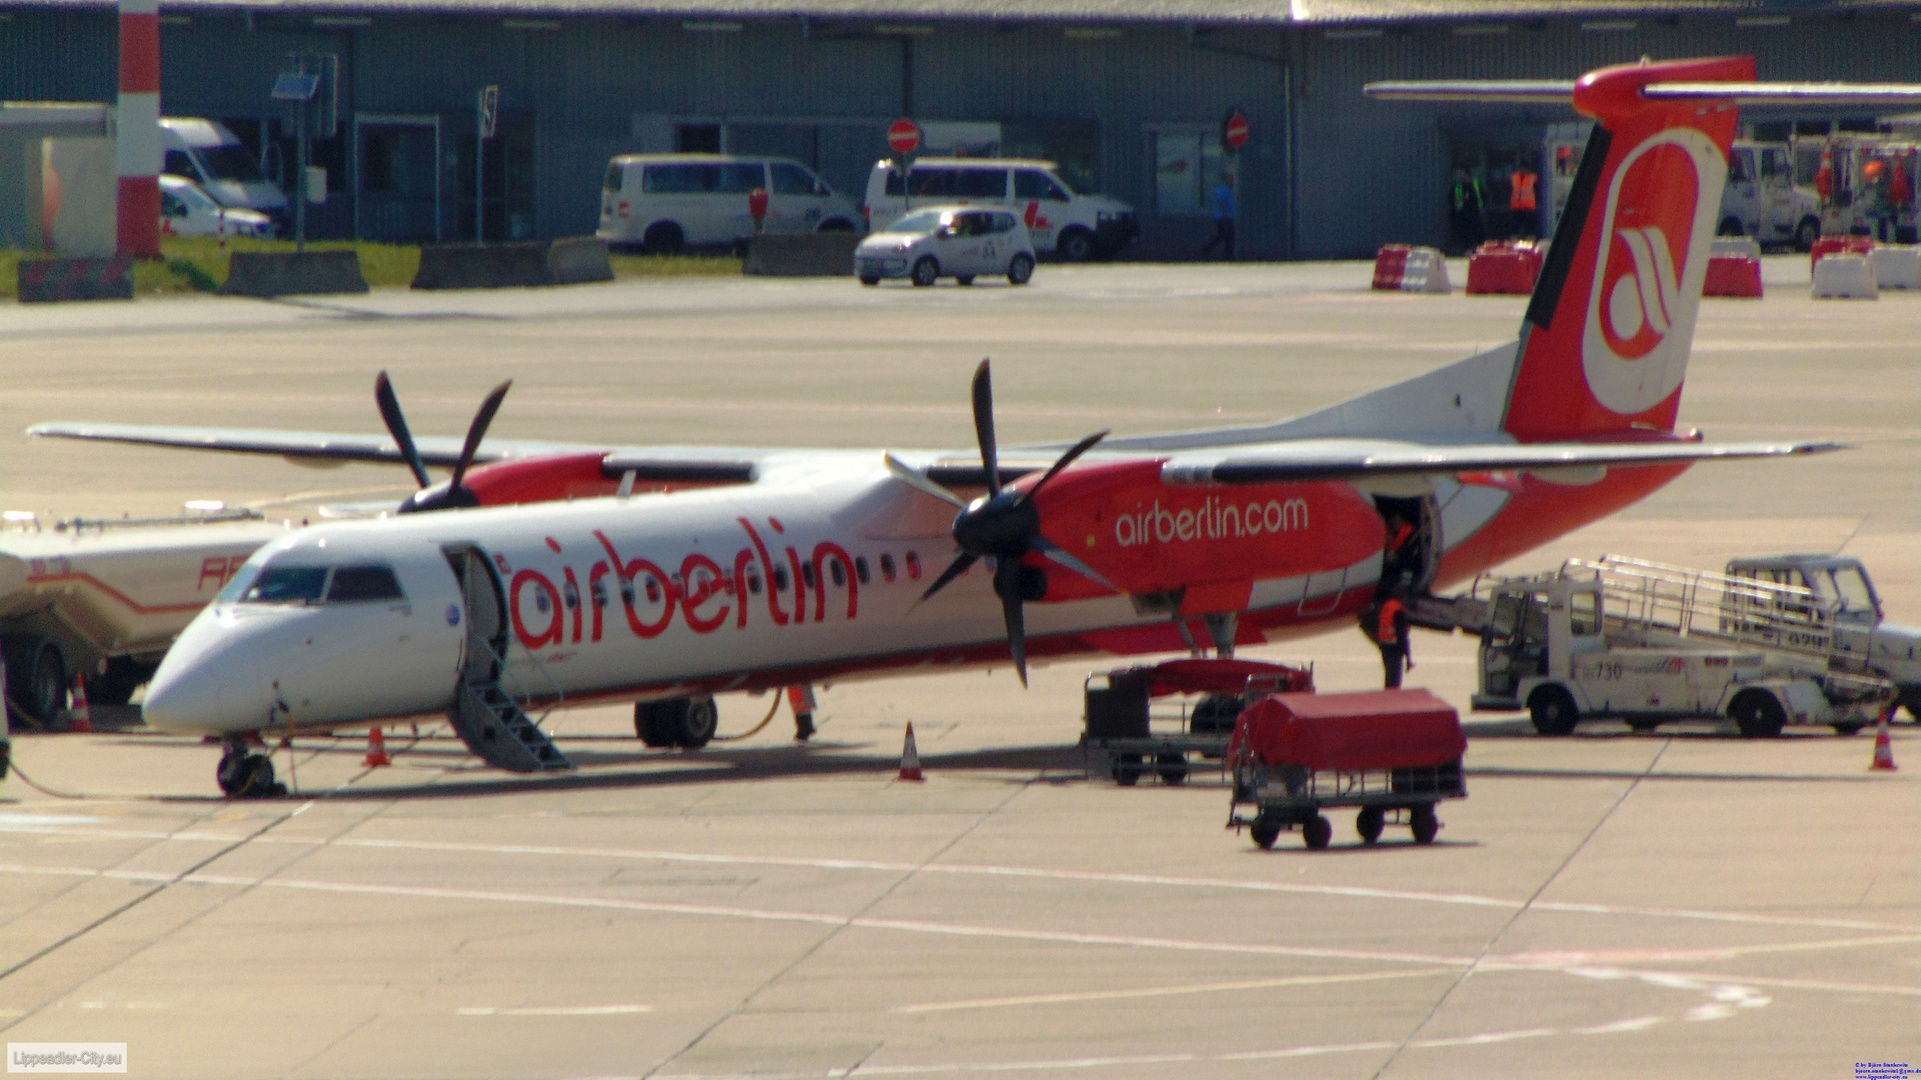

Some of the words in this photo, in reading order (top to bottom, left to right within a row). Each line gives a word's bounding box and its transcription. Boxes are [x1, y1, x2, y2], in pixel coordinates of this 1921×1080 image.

[1115, 495, 1310, 547] airberlin.com
[509, 516, 859, 650] airberlin
[1597, 663, 1623, 681] 730
